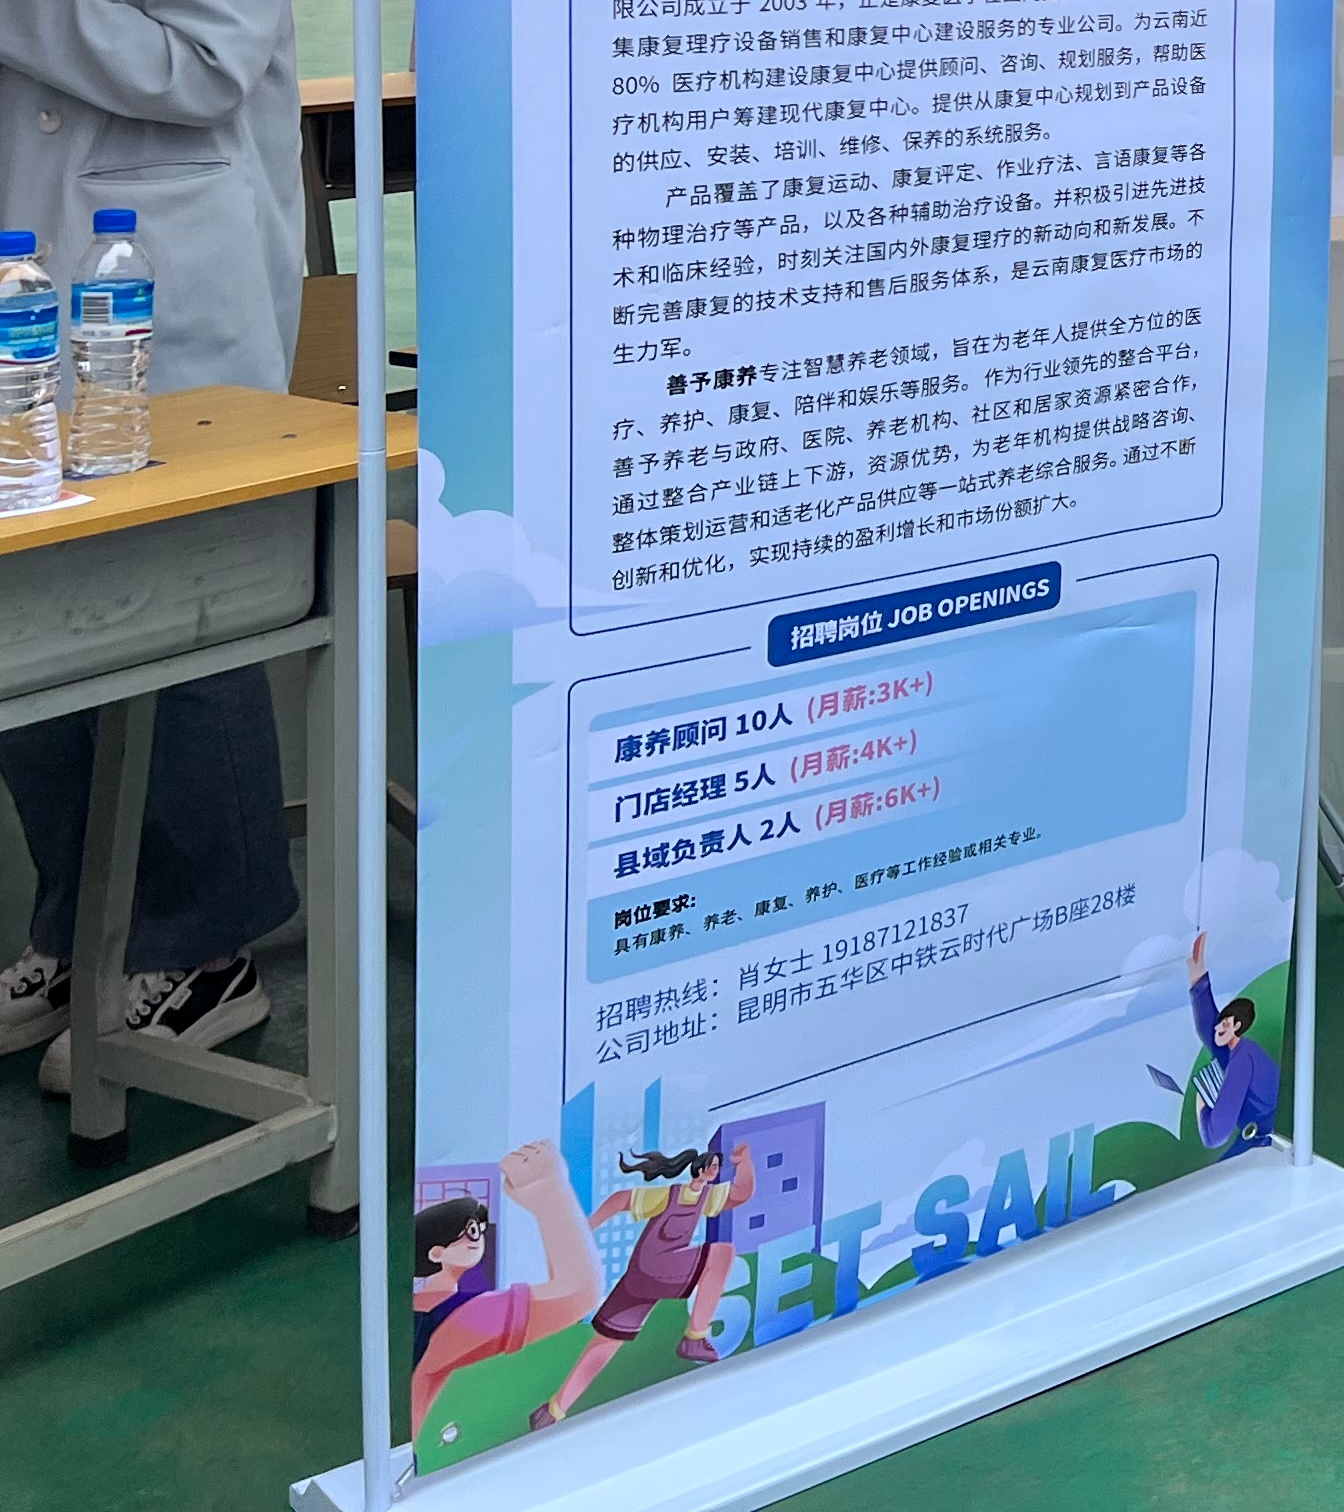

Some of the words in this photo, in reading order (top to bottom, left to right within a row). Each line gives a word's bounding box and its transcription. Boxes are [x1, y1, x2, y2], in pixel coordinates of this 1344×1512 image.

[612, 75, 660, 96] 80%
[612, 336, 692, 365] 生力军。
[791, 610, 883, 651] 招聘岗位
[887, 602, 933, 629] JOB
[937, 578, 1050, 618] OPENINGS
[614, 715, 727, 763] 康养顾问
[735, 702, 793, 736] 10人
[614, 773, 728, 823] 门店经理
[734, 762, 777, 793] 5人
[613, 822, 752, 879] 县域负责人
[759, 811, 801, 842] 2人
[821, 902, 969, 965] 19187121837
[685, 1200, 883, 1360] SET
[911, 1122, 1118, 1276] SAIL
